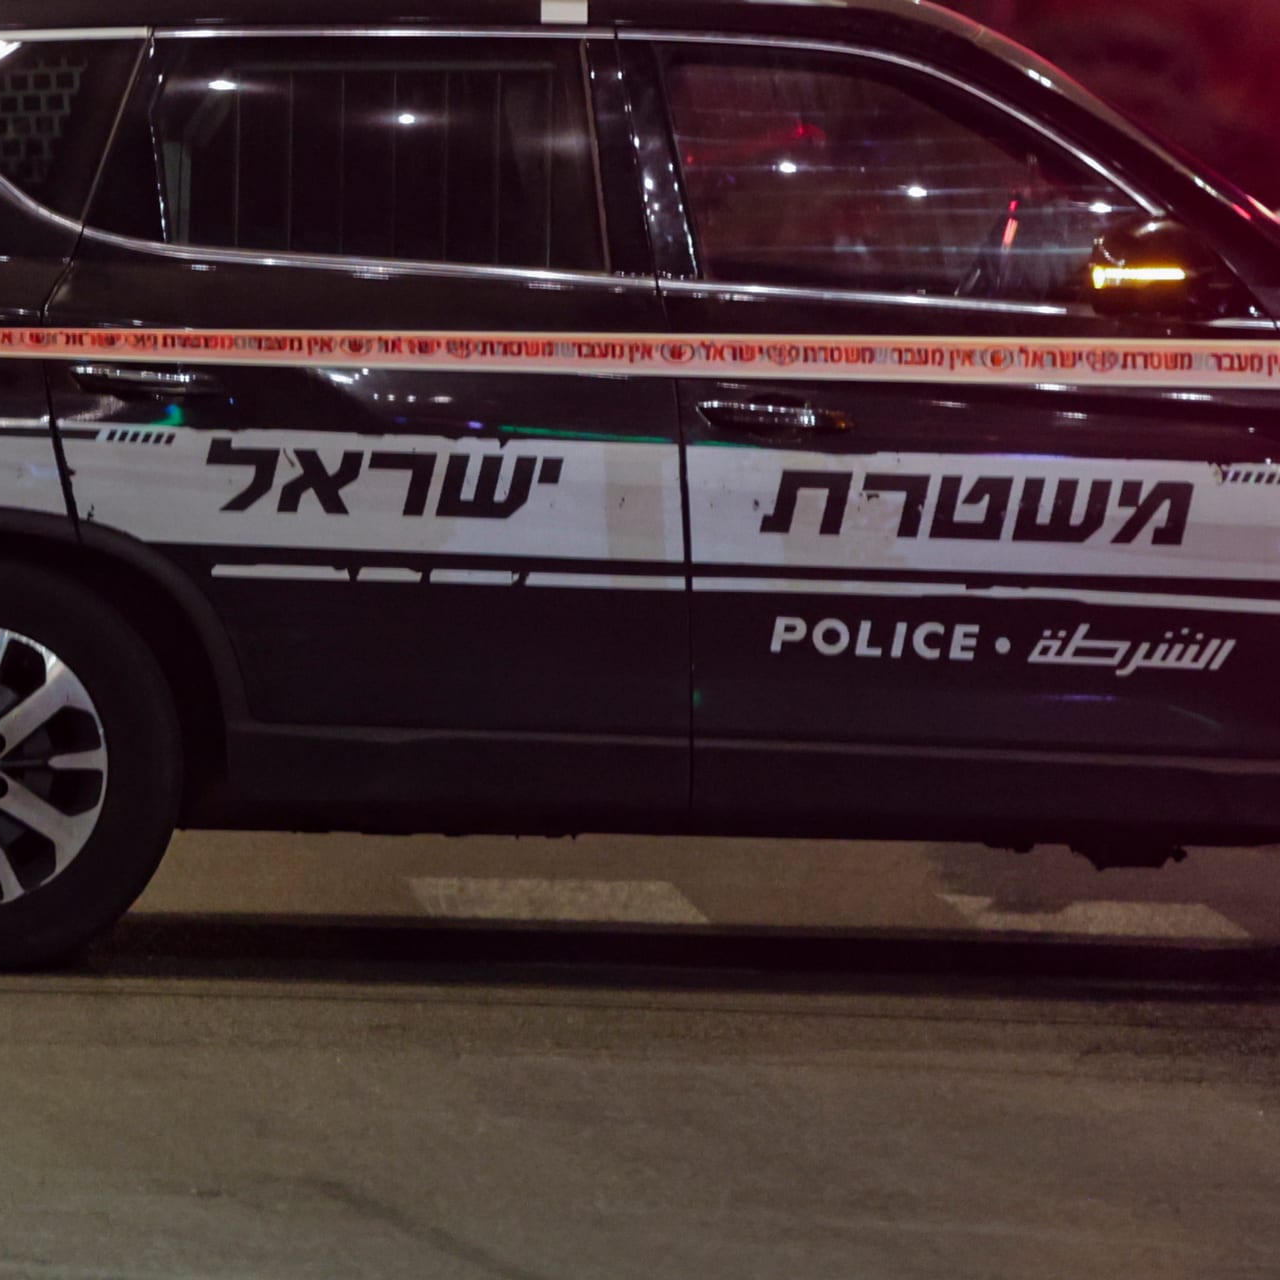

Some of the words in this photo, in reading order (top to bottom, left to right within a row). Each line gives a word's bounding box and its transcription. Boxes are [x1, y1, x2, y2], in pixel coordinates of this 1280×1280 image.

[1019, 346, 1081, 369] ישראל
[1211, 352, 1264, 373] מעבר
[206, 437, 564, 519] ישראל
[761, 468, 1194, 546] משטרת
[770, 616, 980, 662] POLICE
[1027, 622, 1237, 676] الشرطة
